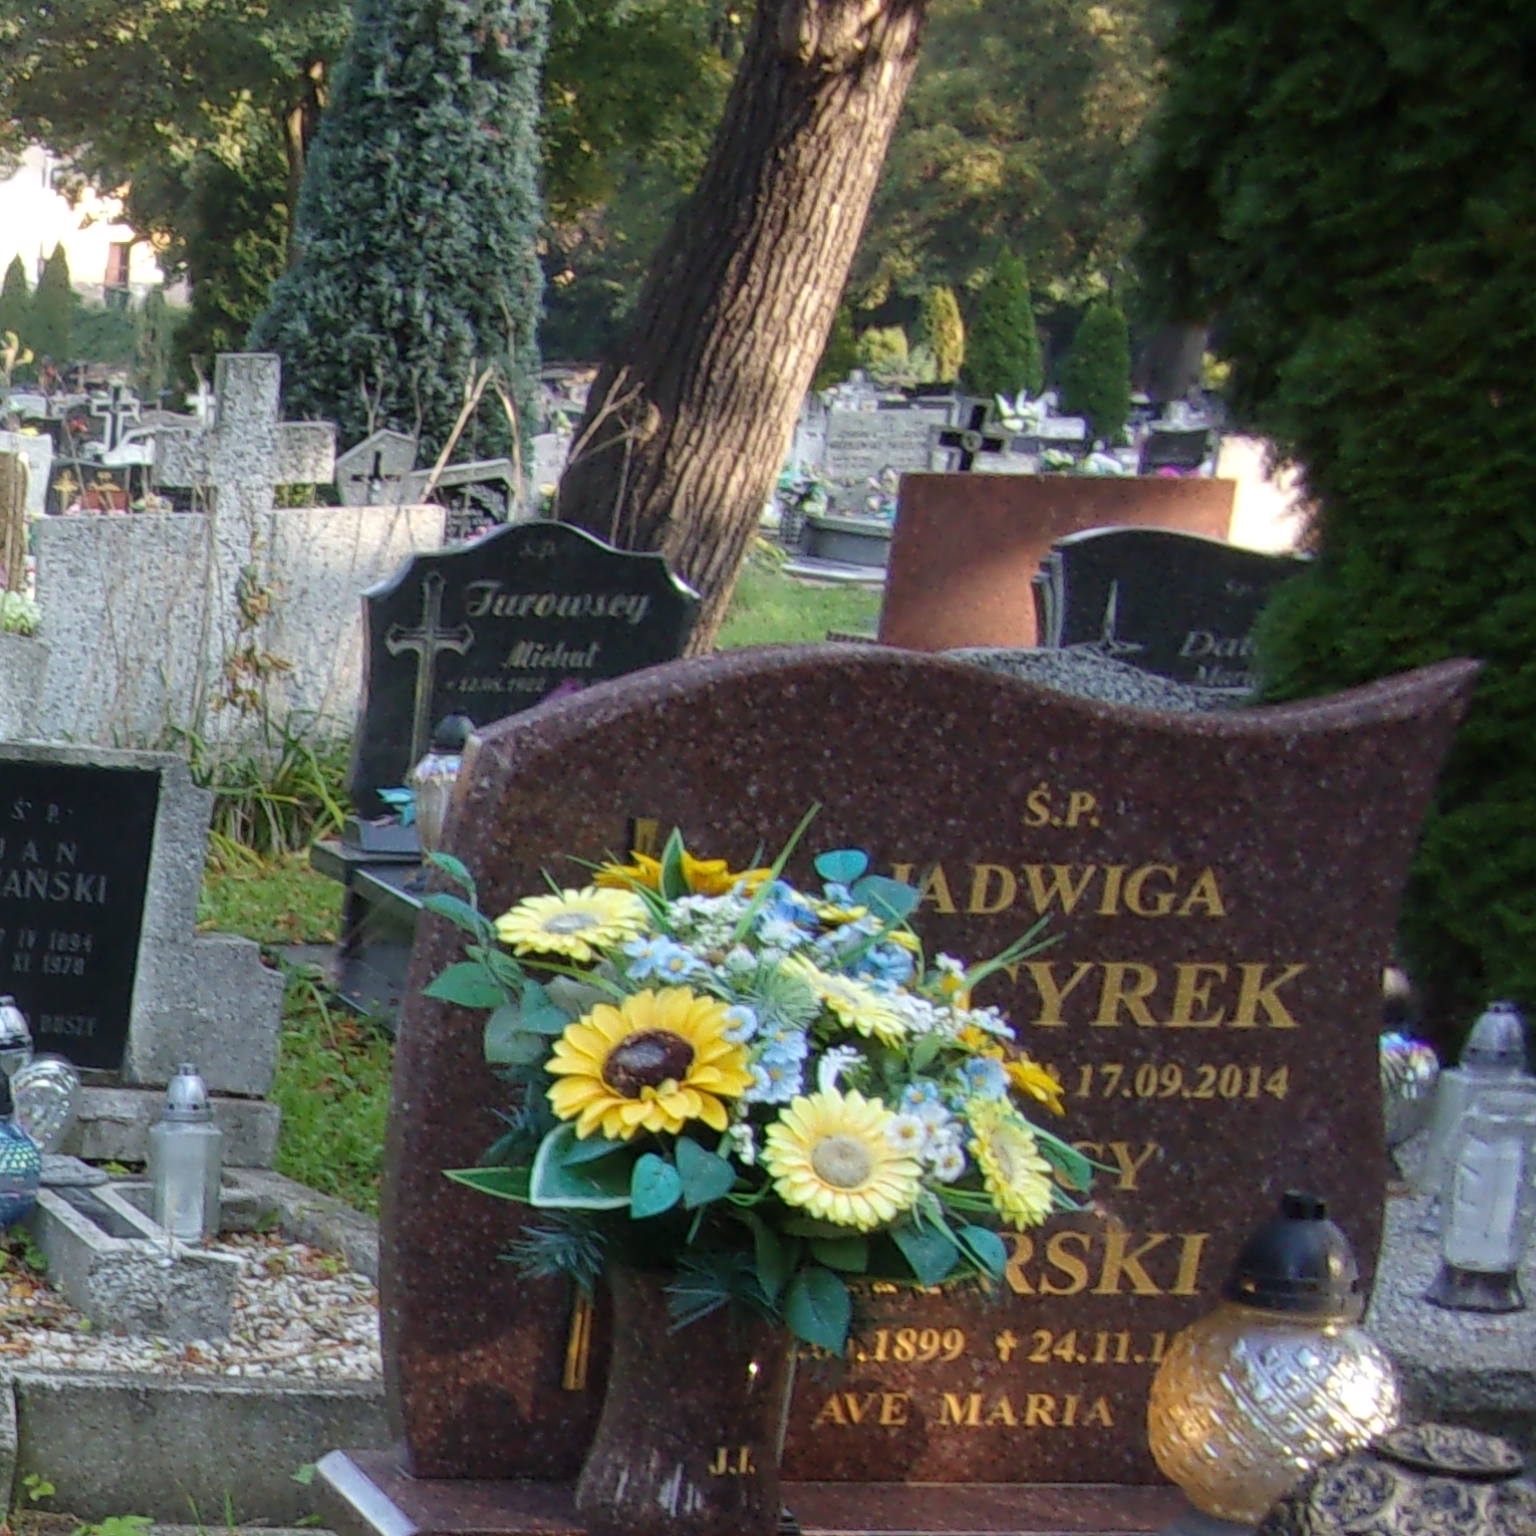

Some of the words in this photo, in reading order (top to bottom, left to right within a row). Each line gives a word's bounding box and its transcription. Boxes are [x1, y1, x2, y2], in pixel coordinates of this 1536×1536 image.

[466, 579, 652, 625] Turowscy
[1023, 782, 1101, 828] Ś.P.
[1078, 1064, 1289, 1099] 17.09.2014
[816, 1393, 909, 1428] AVE
[940, 1393, 1116, 1428] MARIA
